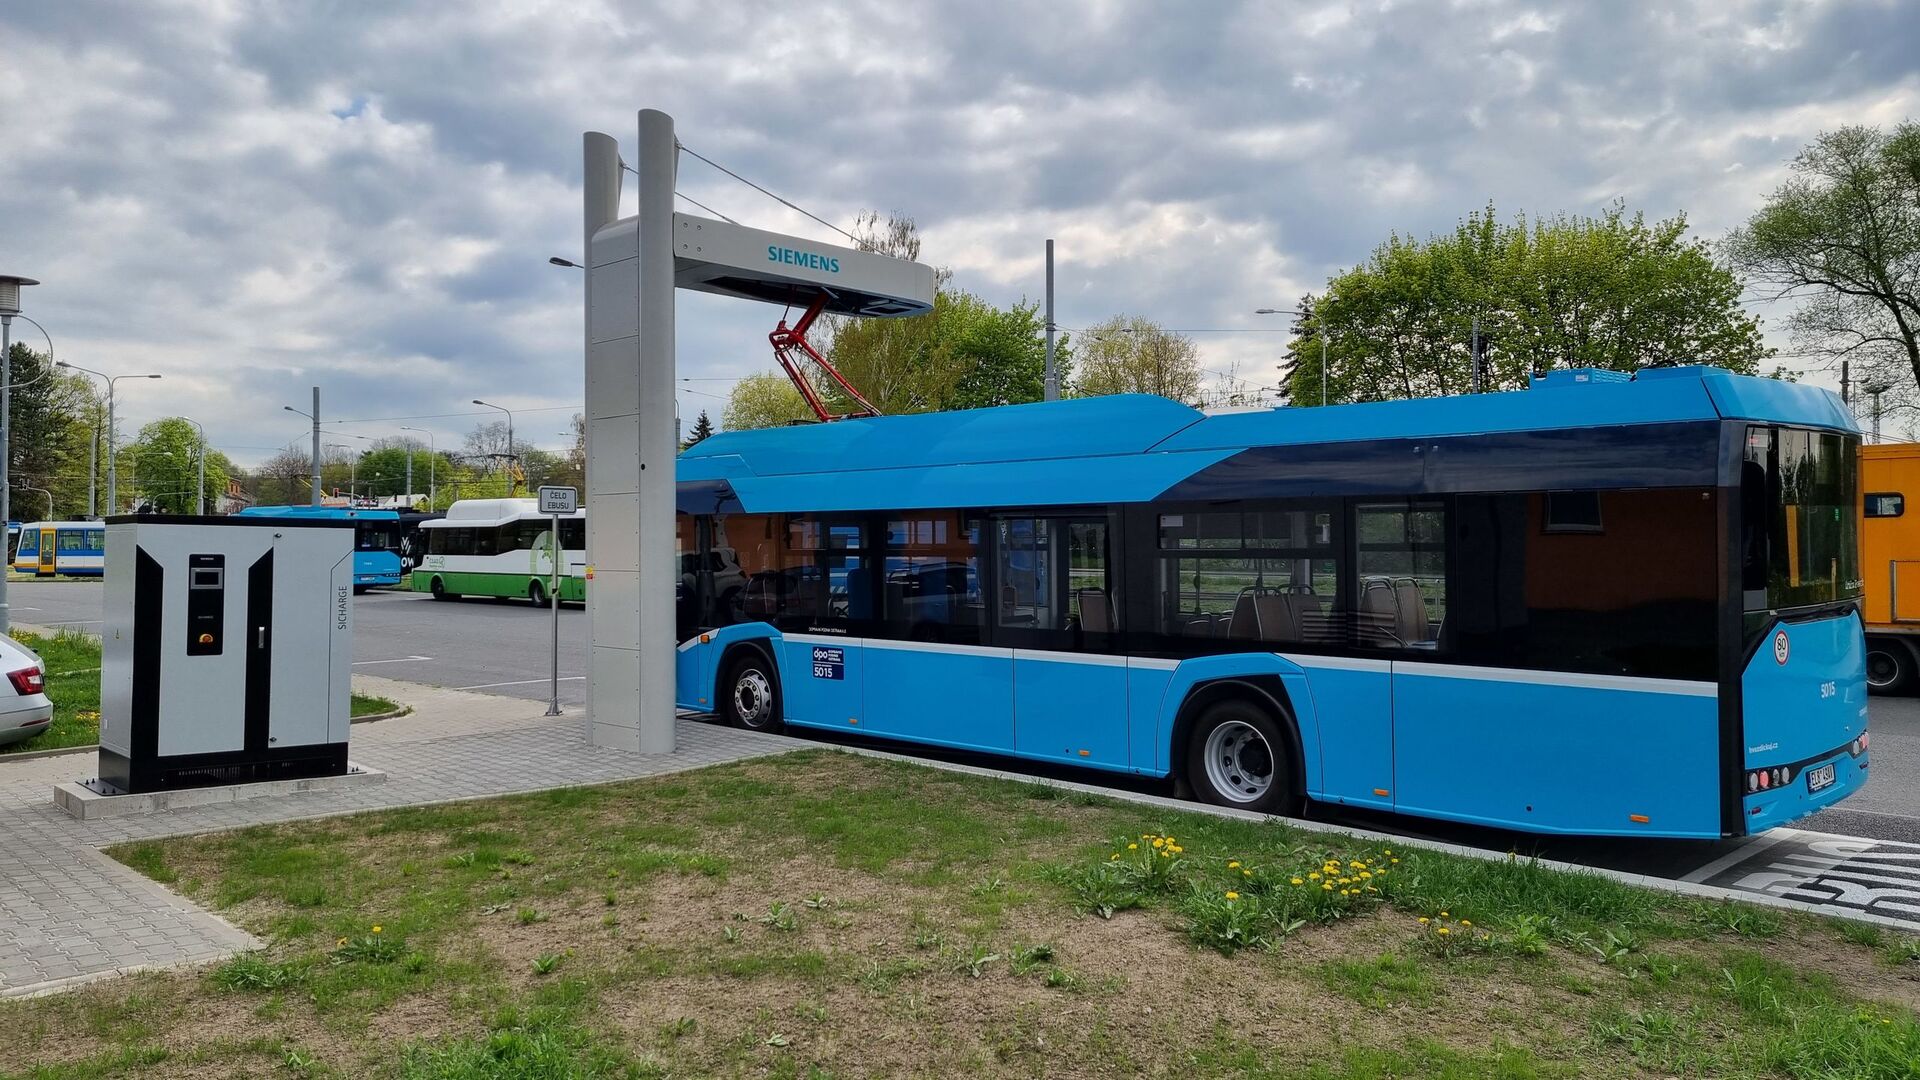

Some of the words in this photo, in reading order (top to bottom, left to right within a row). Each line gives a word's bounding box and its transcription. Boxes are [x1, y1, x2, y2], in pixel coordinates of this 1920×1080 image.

[768, 246, 840, 273] SIEMENS
[550, 491, 567, 500] ČELO
[547, 501, 570, 510] EBUSU
[338, 585, 348, 630] SICHARGE
[1776, 638, 1786, 651] 80
[814, 648, 828, 660] dpo
[815, 667, 833, 677] 5015
[1820, 681, 1836, 698] 5015
